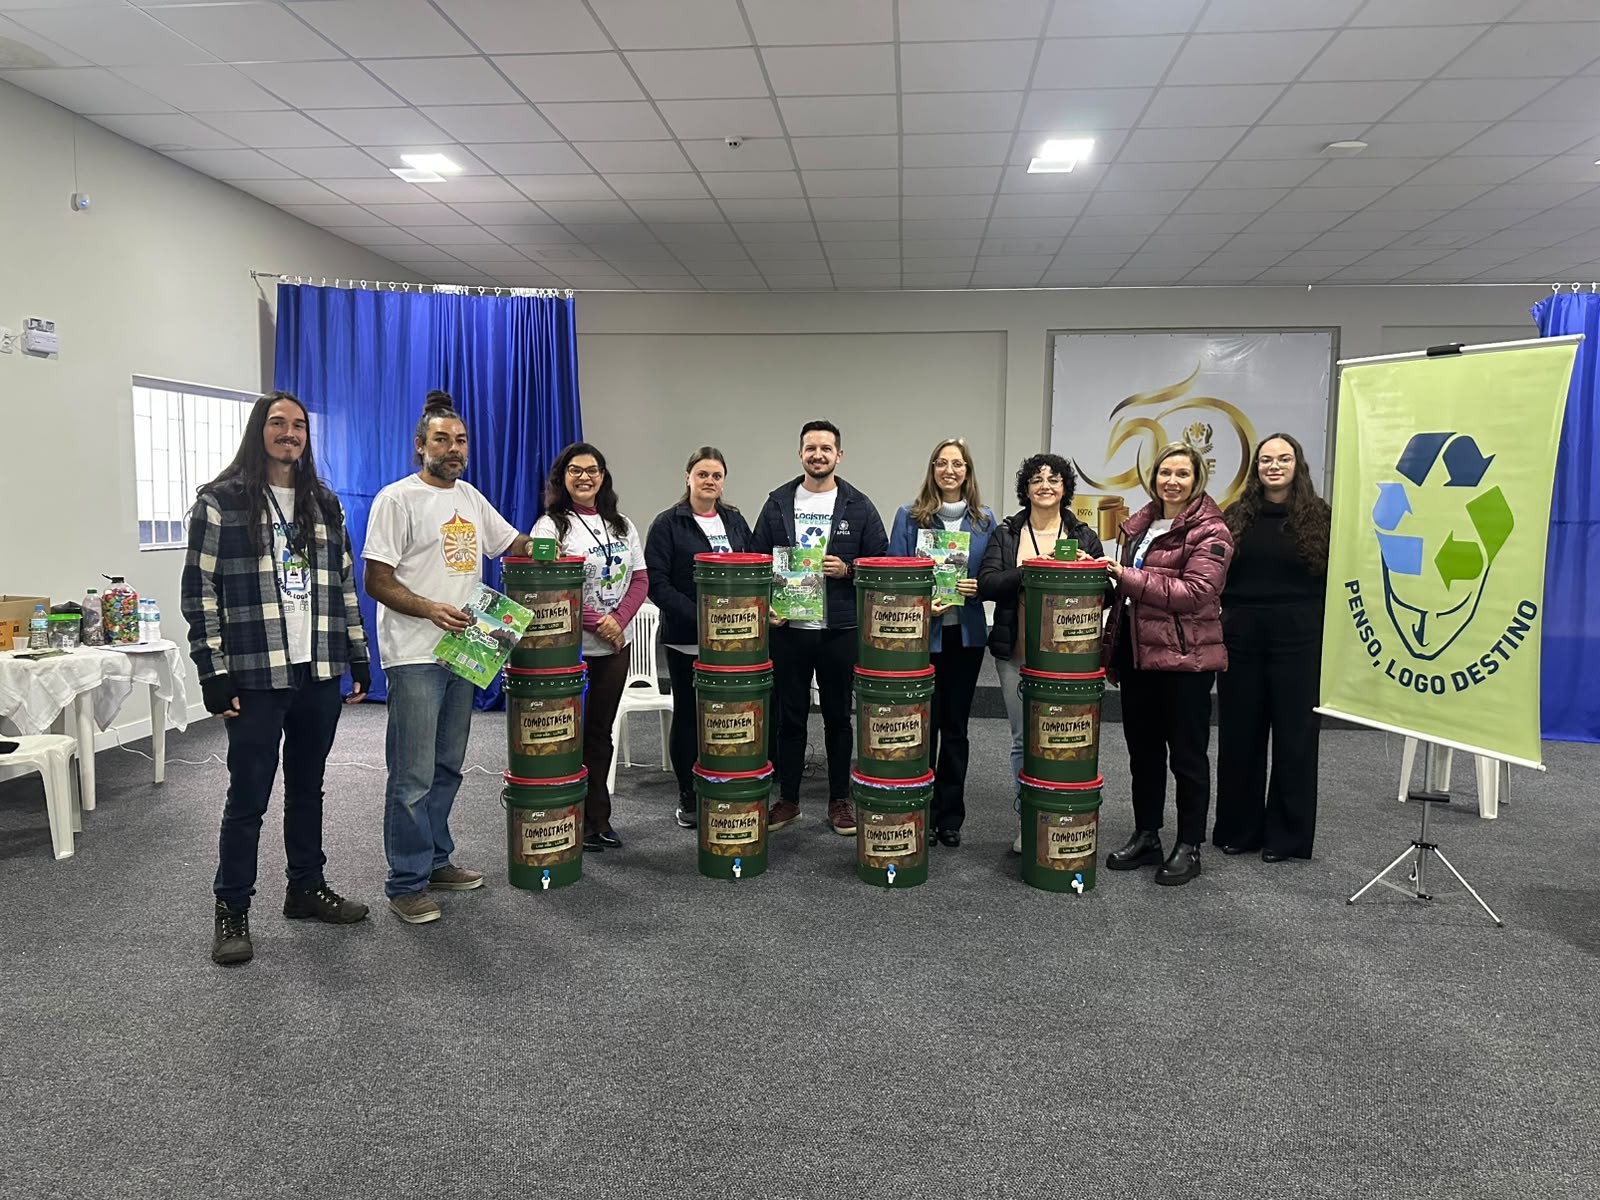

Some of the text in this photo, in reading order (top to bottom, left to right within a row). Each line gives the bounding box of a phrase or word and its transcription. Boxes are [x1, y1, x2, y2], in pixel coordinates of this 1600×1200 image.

[533, 606, 569, 619] POSTAGEM
[710, 613, 756, 624] COMPOSTAGEM
[875, 611, 921, 622] COMPOSTAGEM
[1056, 612, 1100, 624] COMPOSTAGEM
[1344, 579, 1538, 695] PENSO, LOGO DESTINO
[523, 716, 573, 728] COMPOSTAGEM
[706, 718, 752, 729] COMPOSTAGEM
[872, 720, 919, 732] COMPOSTAGEM
[1041, 720, 1091, 732] COMPOSTAGEM
[710, 818, 757, 829] COMPOSTAGEM
[524, 824, 574, 838] COMPOSTAGEM
[866, 829, 913, 841] COMPOSTAGEM
[1051, 829, 1095, 842] COMPOSTAGEM
